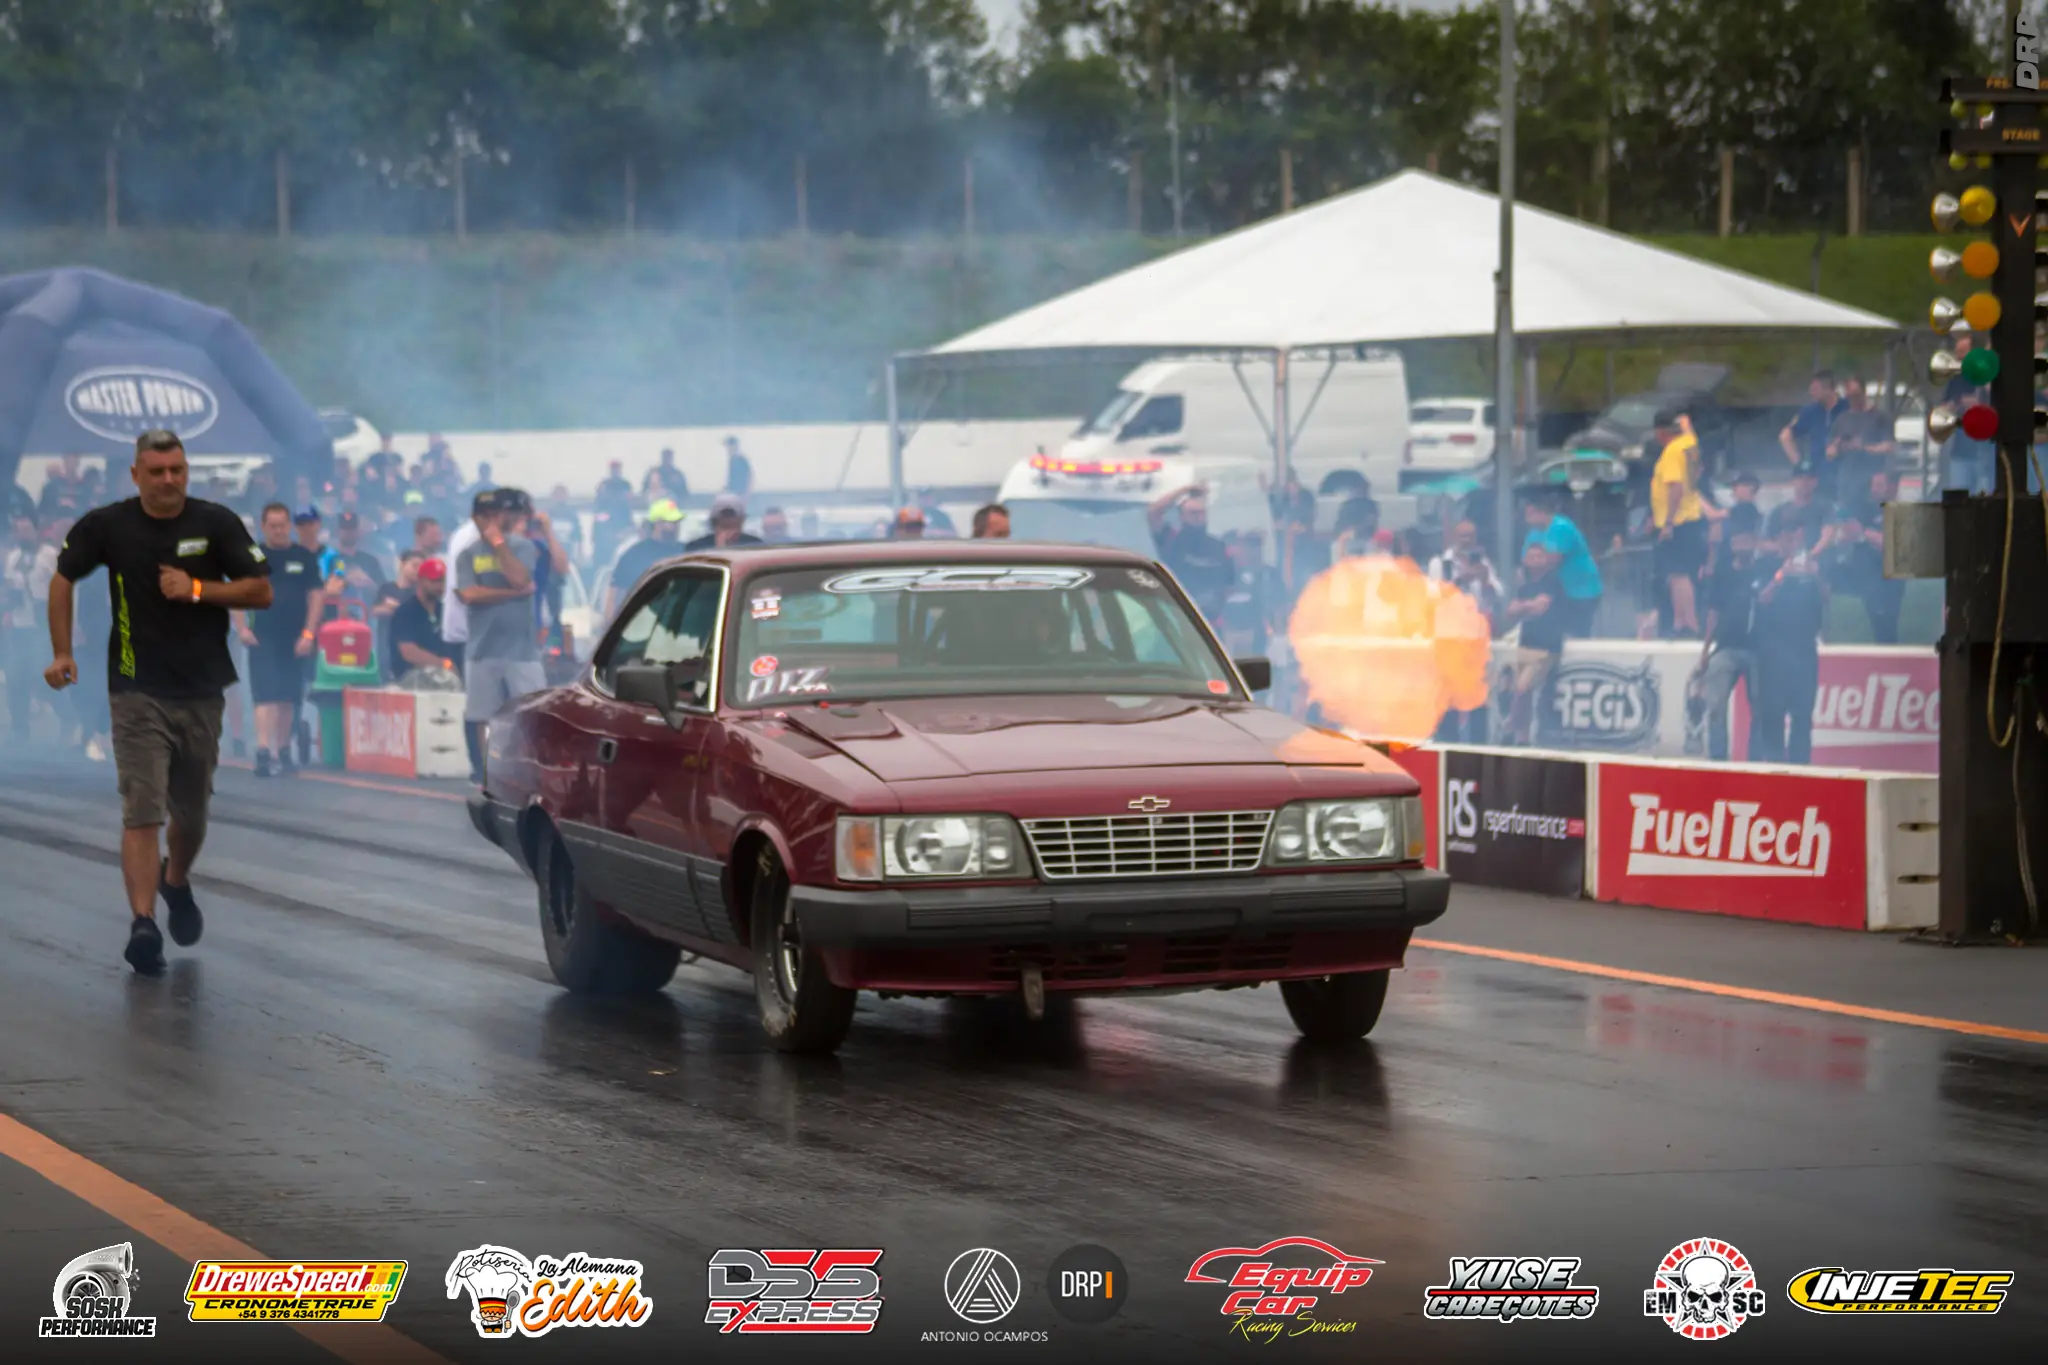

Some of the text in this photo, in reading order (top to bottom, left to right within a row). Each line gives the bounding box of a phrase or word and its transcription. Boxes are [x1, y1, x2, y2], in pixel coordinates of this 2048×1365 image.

[2002, 128, 2040, 141] STAGE
[1811, 672, 1940, 731] uelTec
[1447, 779, 1478, 838] RS
[1628, 793, 1832, 877] FuelTech
